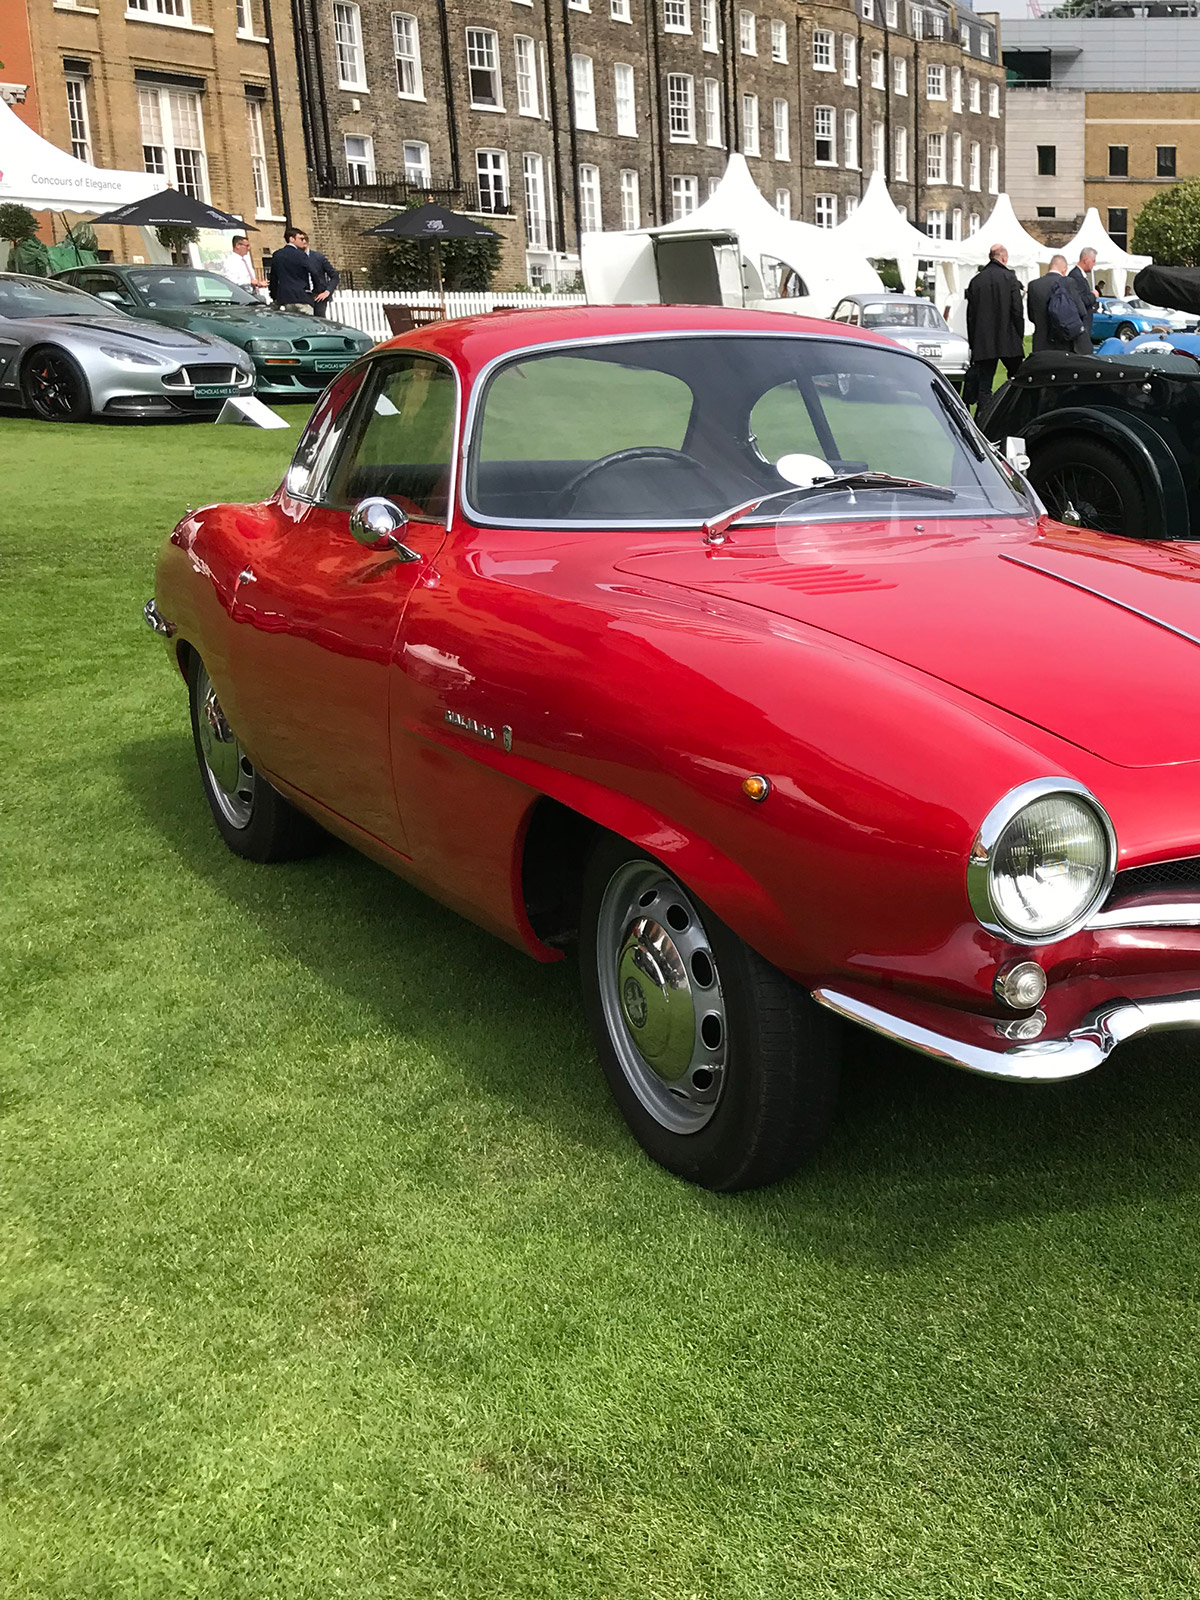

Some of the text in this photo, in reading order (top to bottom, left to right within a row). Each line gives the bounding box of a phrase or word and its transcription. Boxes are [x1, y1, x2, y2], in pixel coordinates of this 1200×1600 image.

[31, 174, 122, 191] Concours of Elegance
